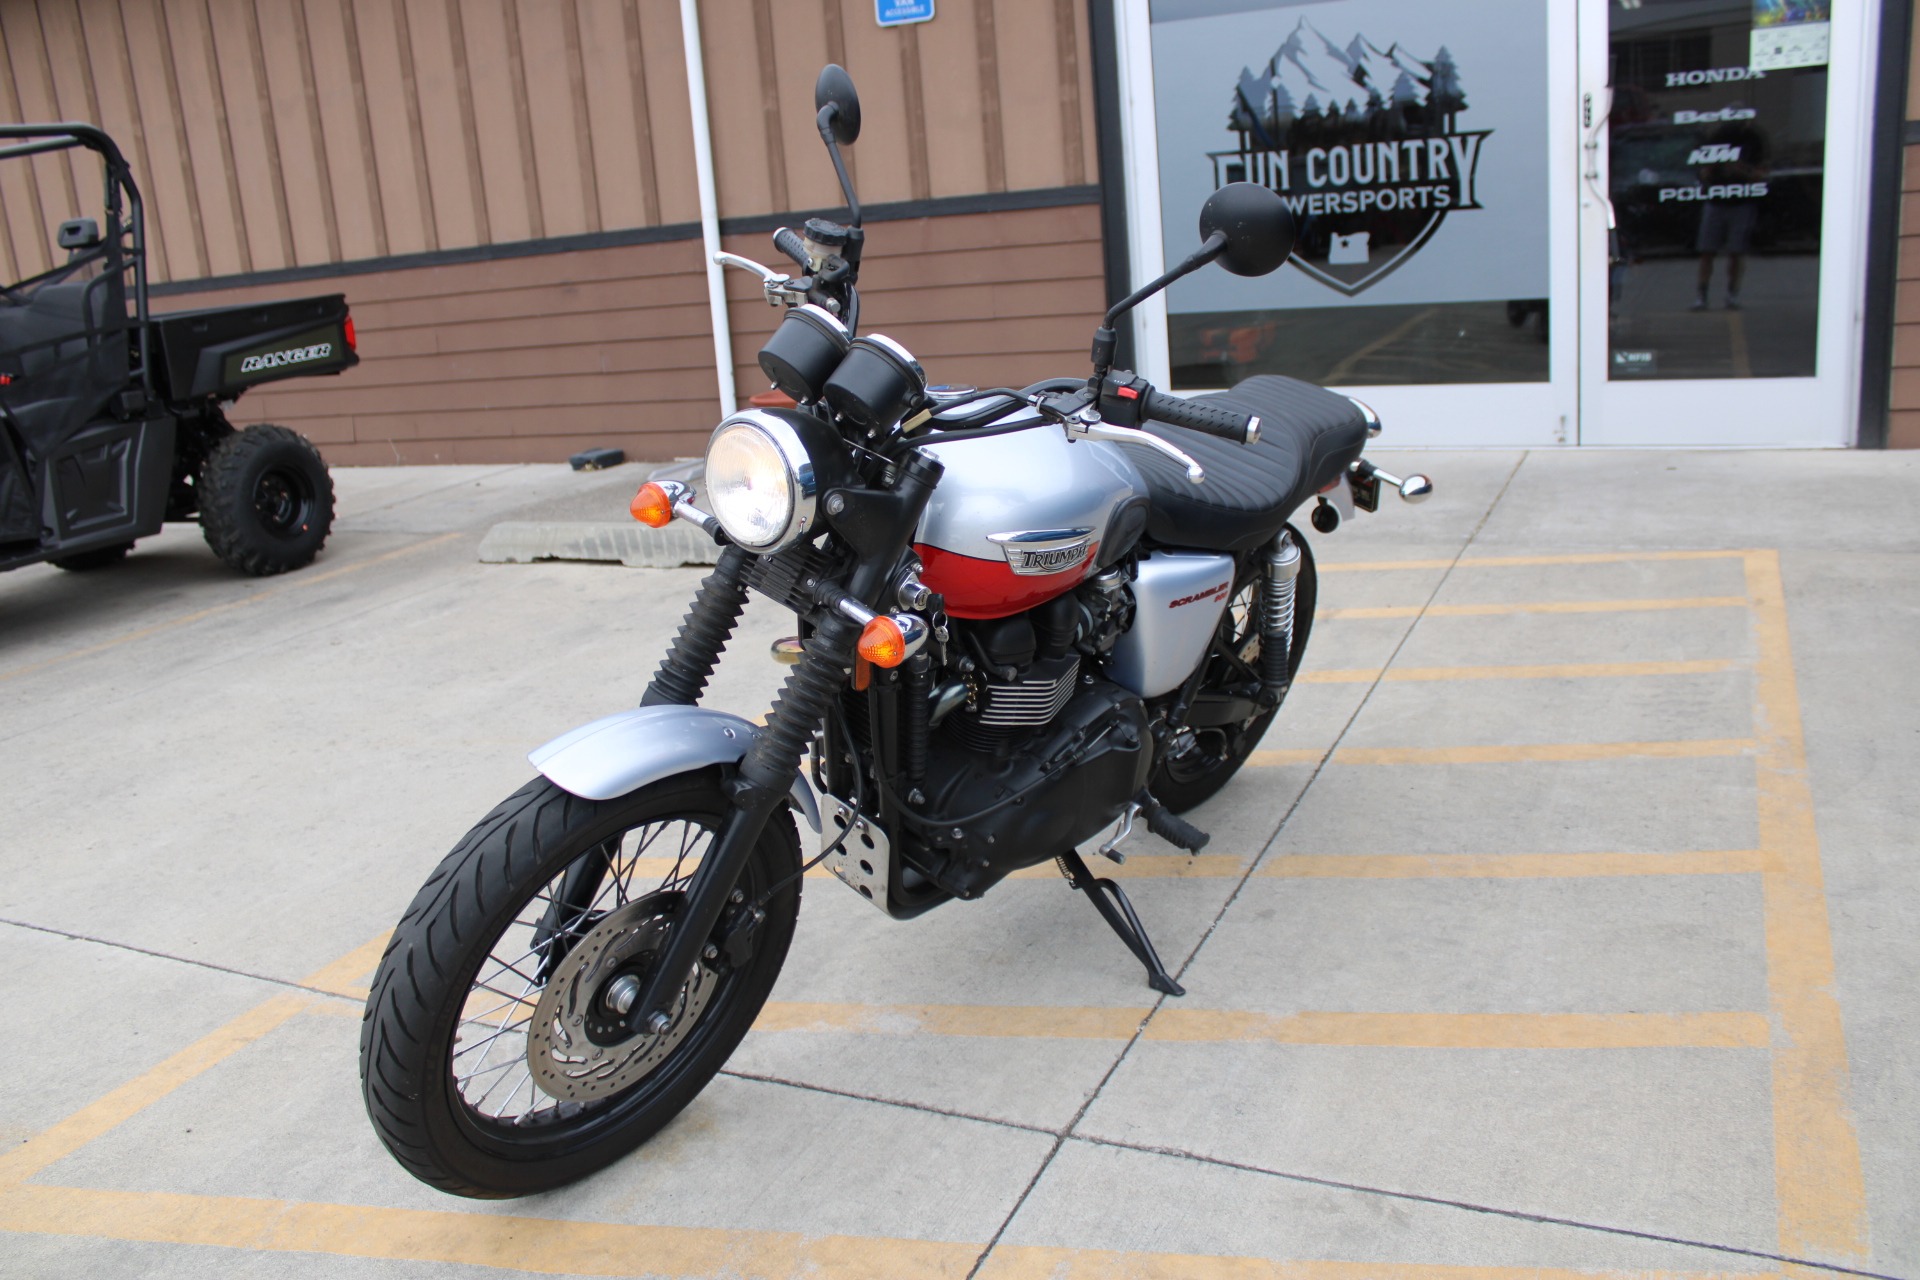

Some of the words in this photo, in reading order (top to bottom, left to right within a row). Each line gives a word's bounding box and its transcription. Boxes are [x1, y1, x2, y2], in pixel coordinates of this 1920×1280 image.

[1665, 66, 1765, 87] HONDA
[1687, 143, 1741, 165] KTM
[1217, 151, 1290, 191] FUN
[1306, 135, 1482, 206] COUNTRY
[1283, 185, 1450, 215] WERSPORTS
[1659, 182, 1769, 203] POLARIS
[241, 343, 331, 372] RANGER
[1021, 544, 1088, 571] TRIUMPH
